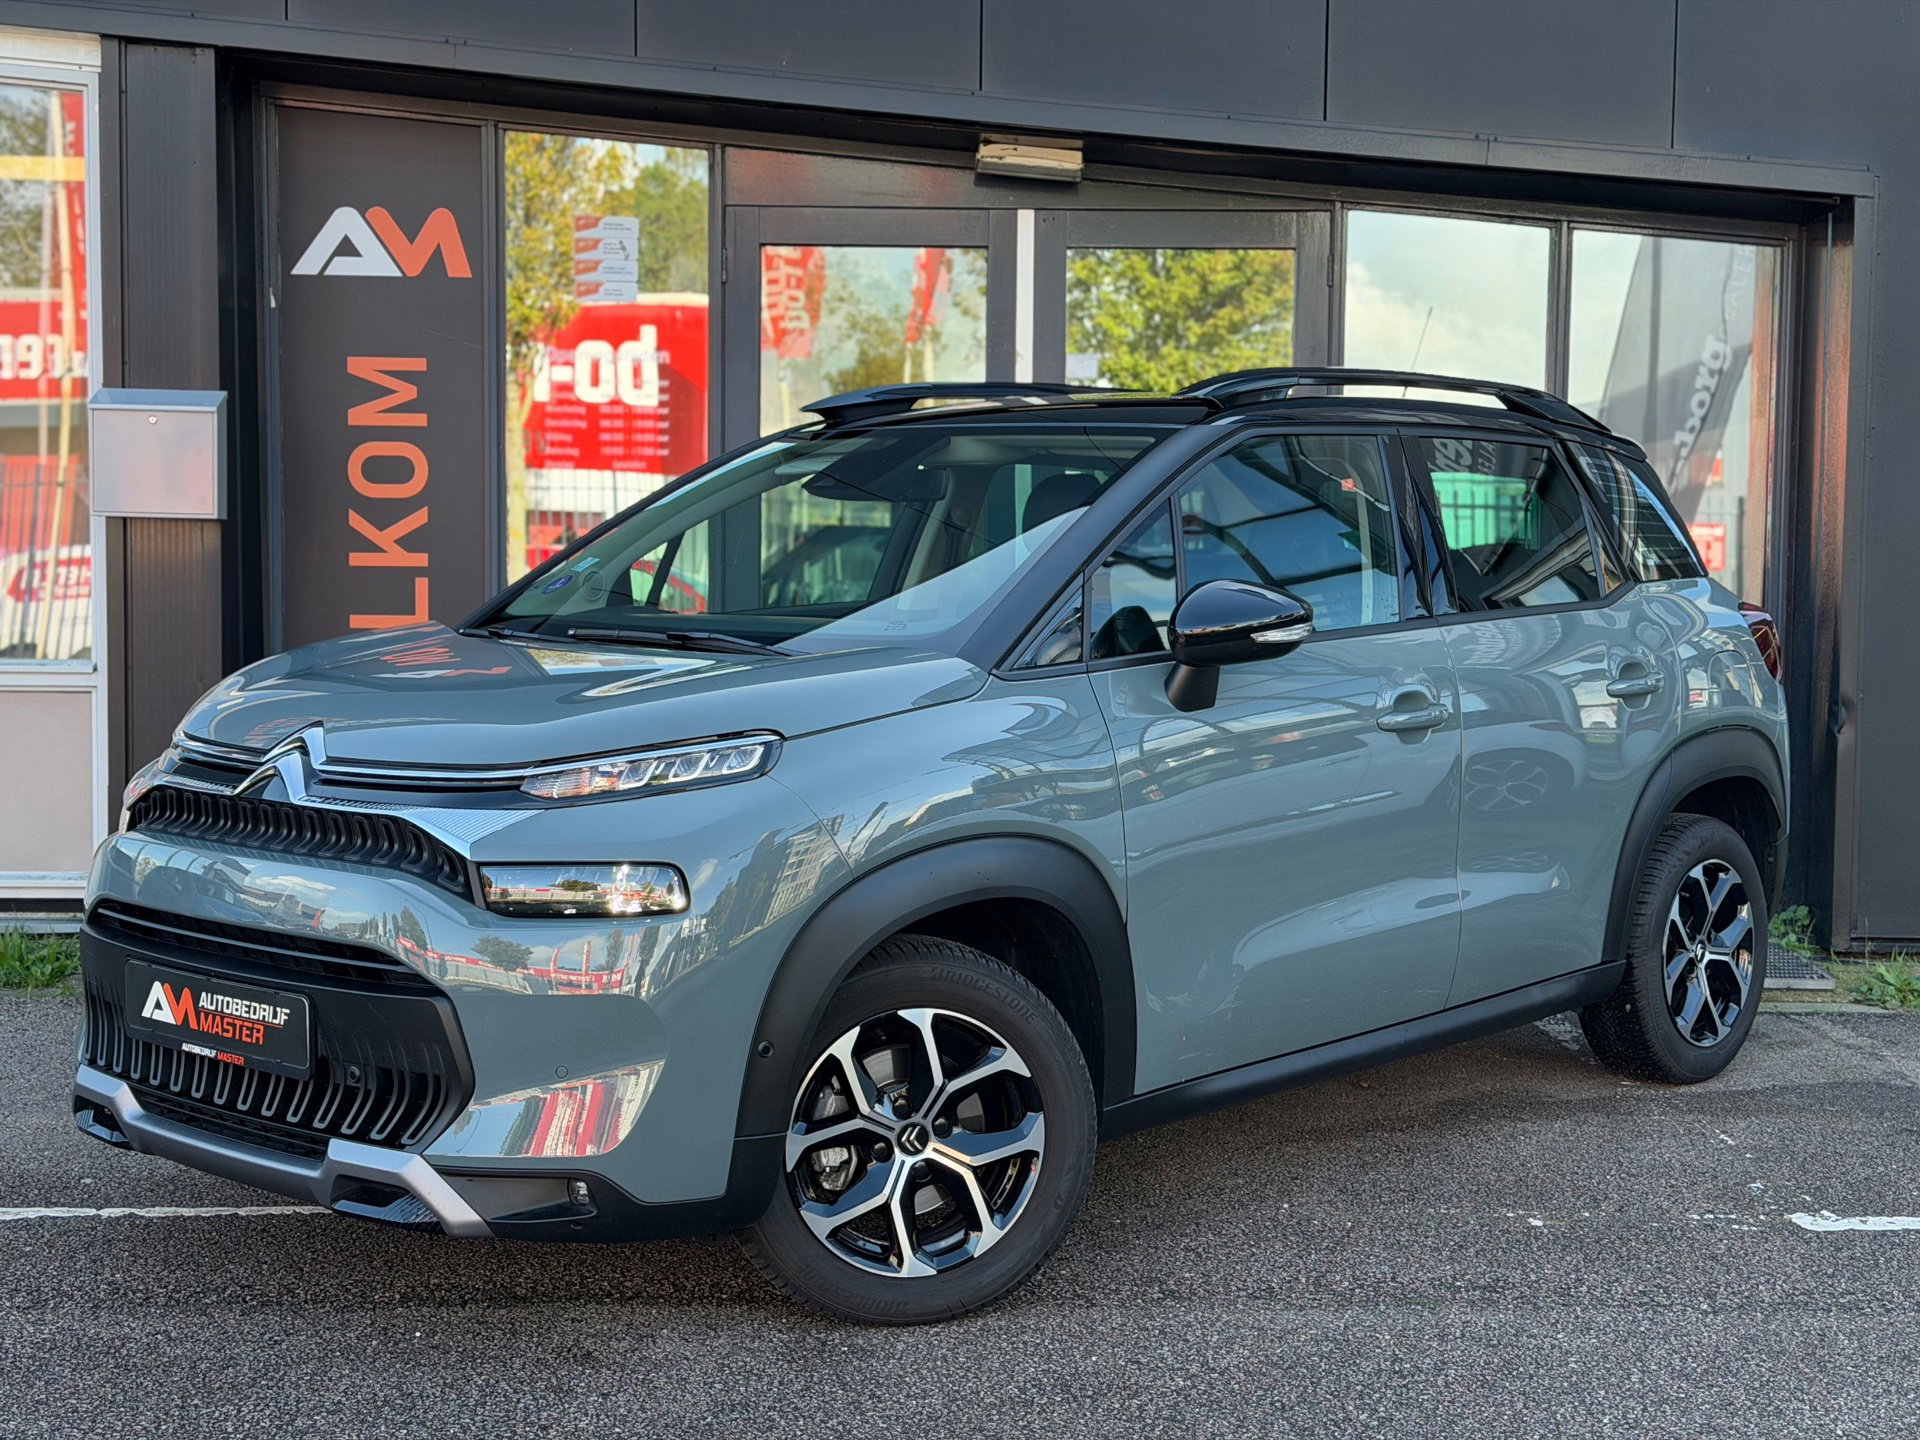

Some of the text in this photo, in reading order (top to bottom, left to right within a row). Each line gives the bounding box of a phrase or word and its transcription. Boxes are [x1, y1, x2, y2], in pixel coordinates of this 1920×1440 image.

[1672, 334, 1732, 456] borg
[199, 992, 290, 1025] AUTOBEDRIJF
[929, 966, 1037, 1024] BRIDGESTONE
[200, 1012, 264, 1045] MASTER
[181, 1043, 244, 1066] AUTOBEDRIJF MASTER
